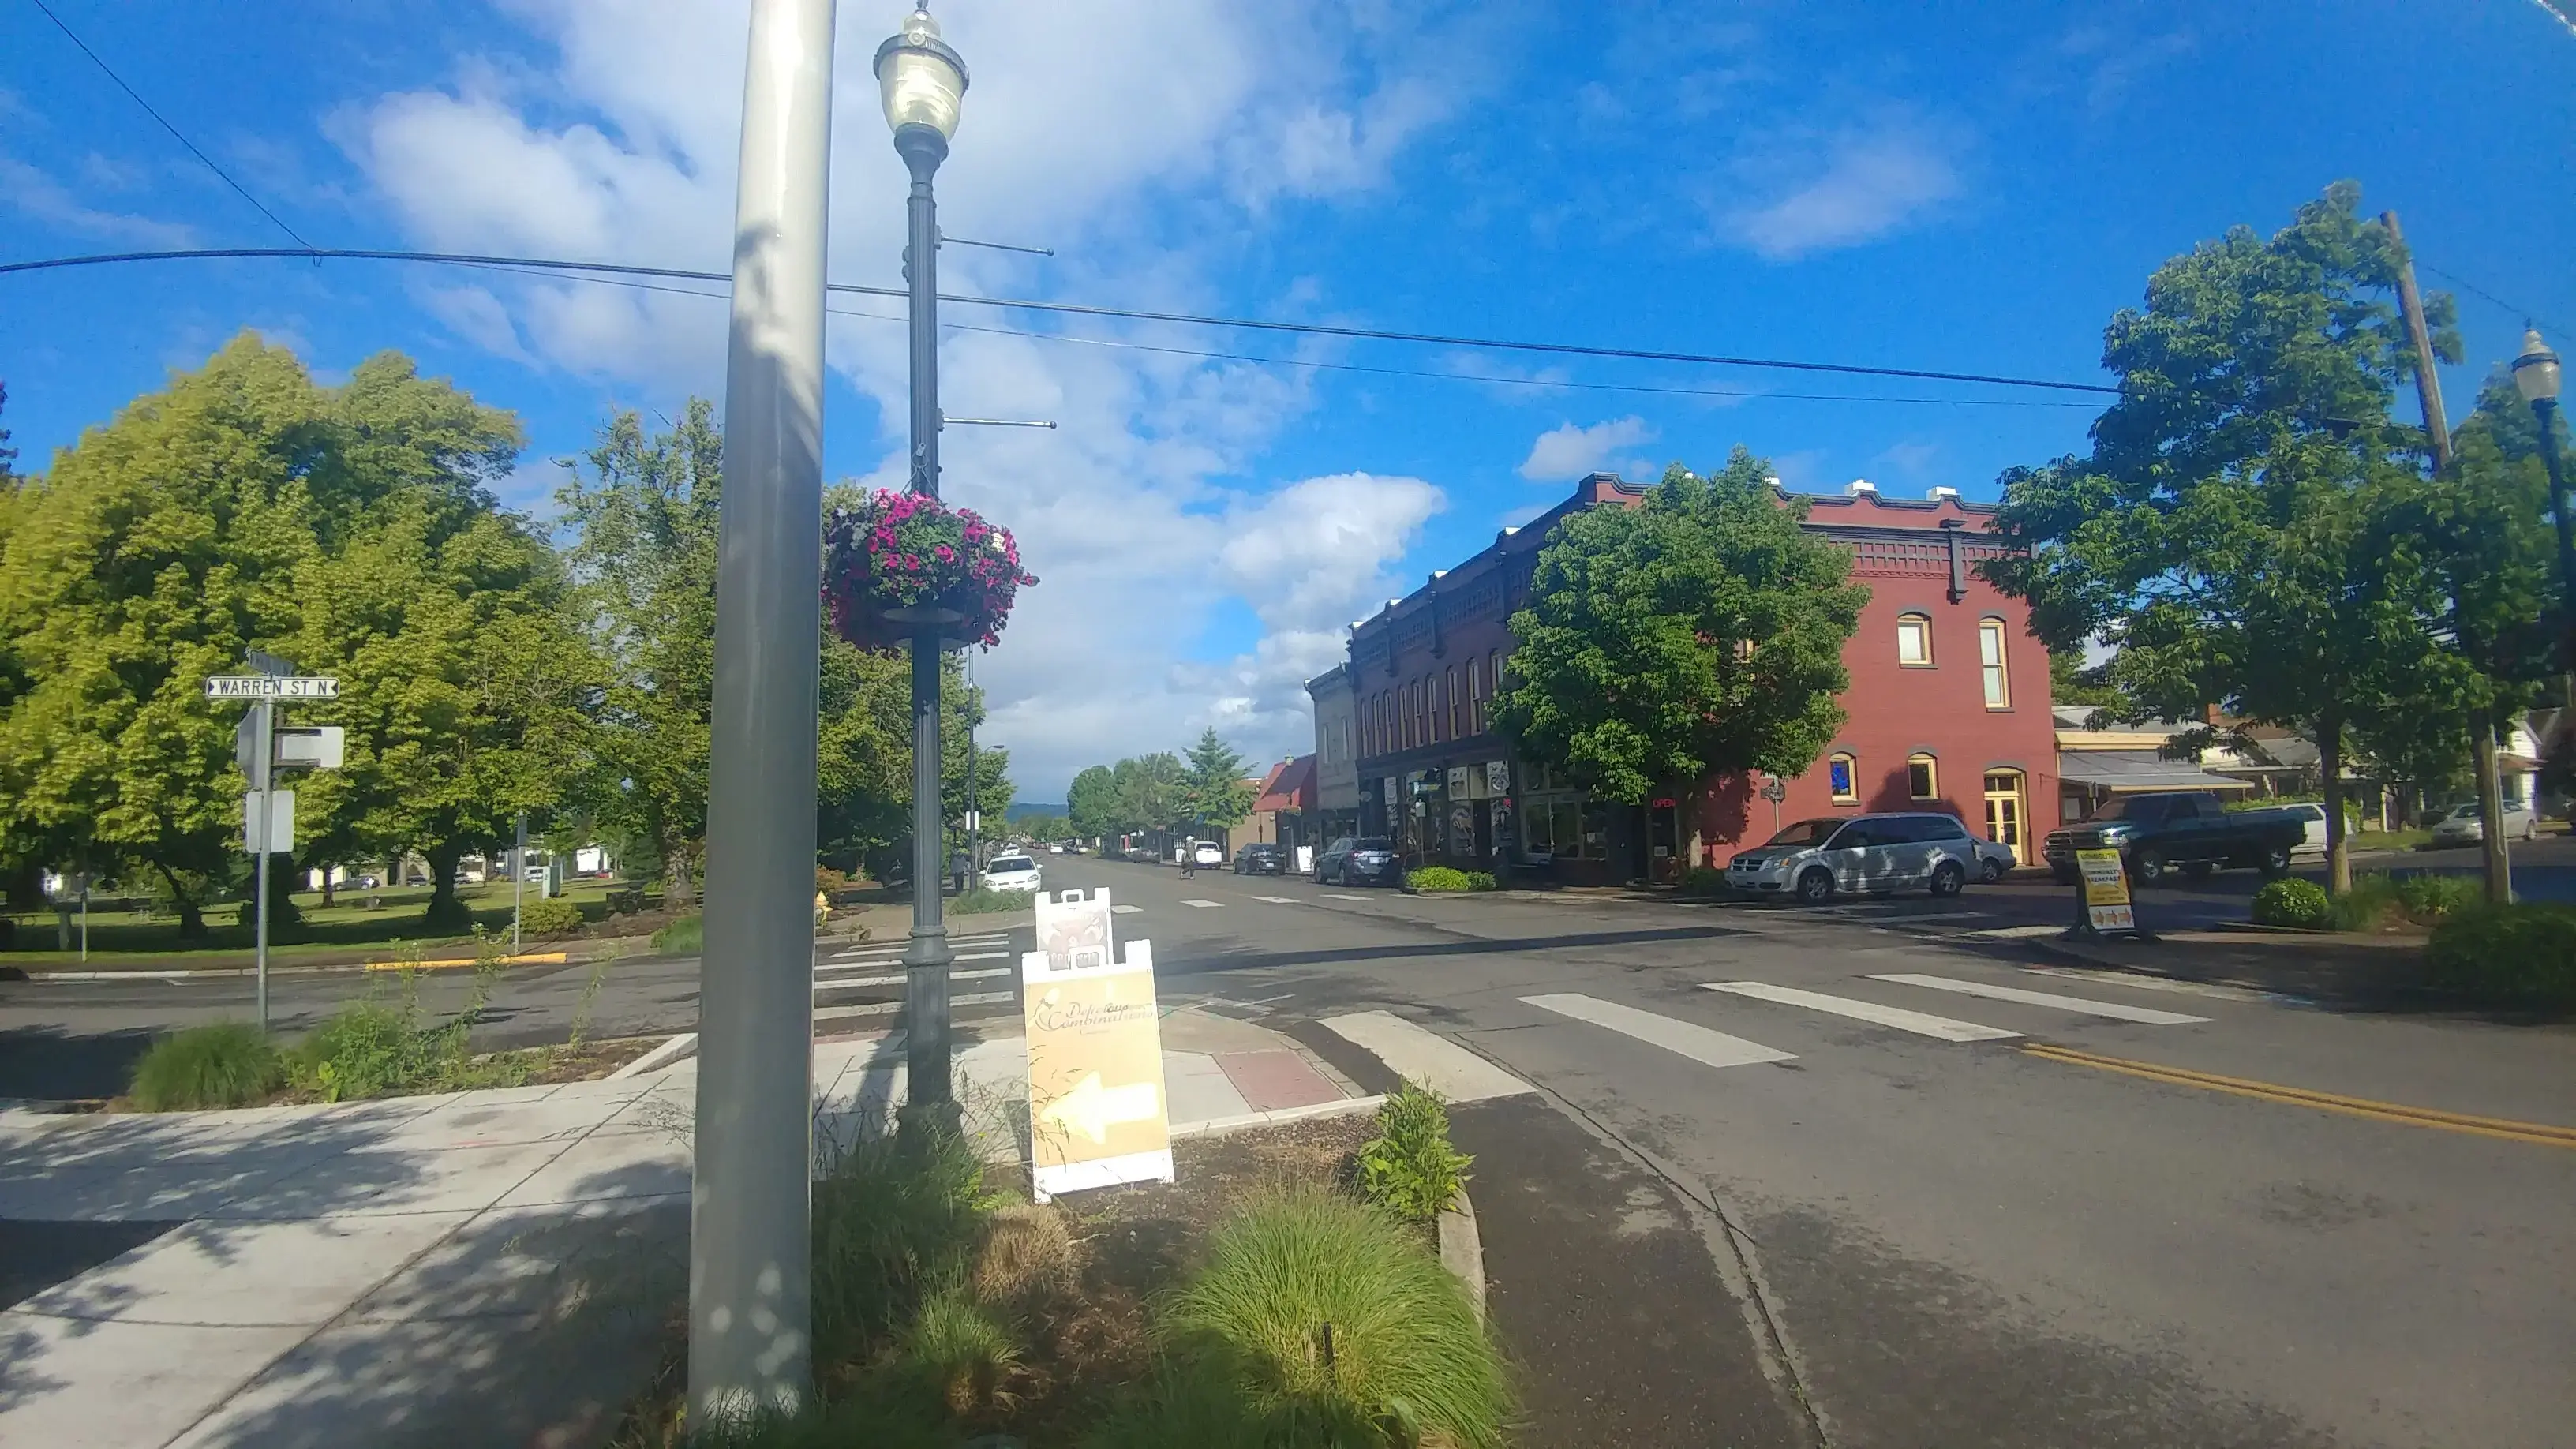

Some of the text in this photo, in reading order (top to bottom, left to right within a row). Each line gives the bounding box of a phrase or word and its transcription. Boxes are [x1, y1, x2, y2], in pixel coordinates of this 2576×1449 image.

[219, 680, 328, 695] WARREN ST N
[1653, 798, 1676, 808] OPEN
